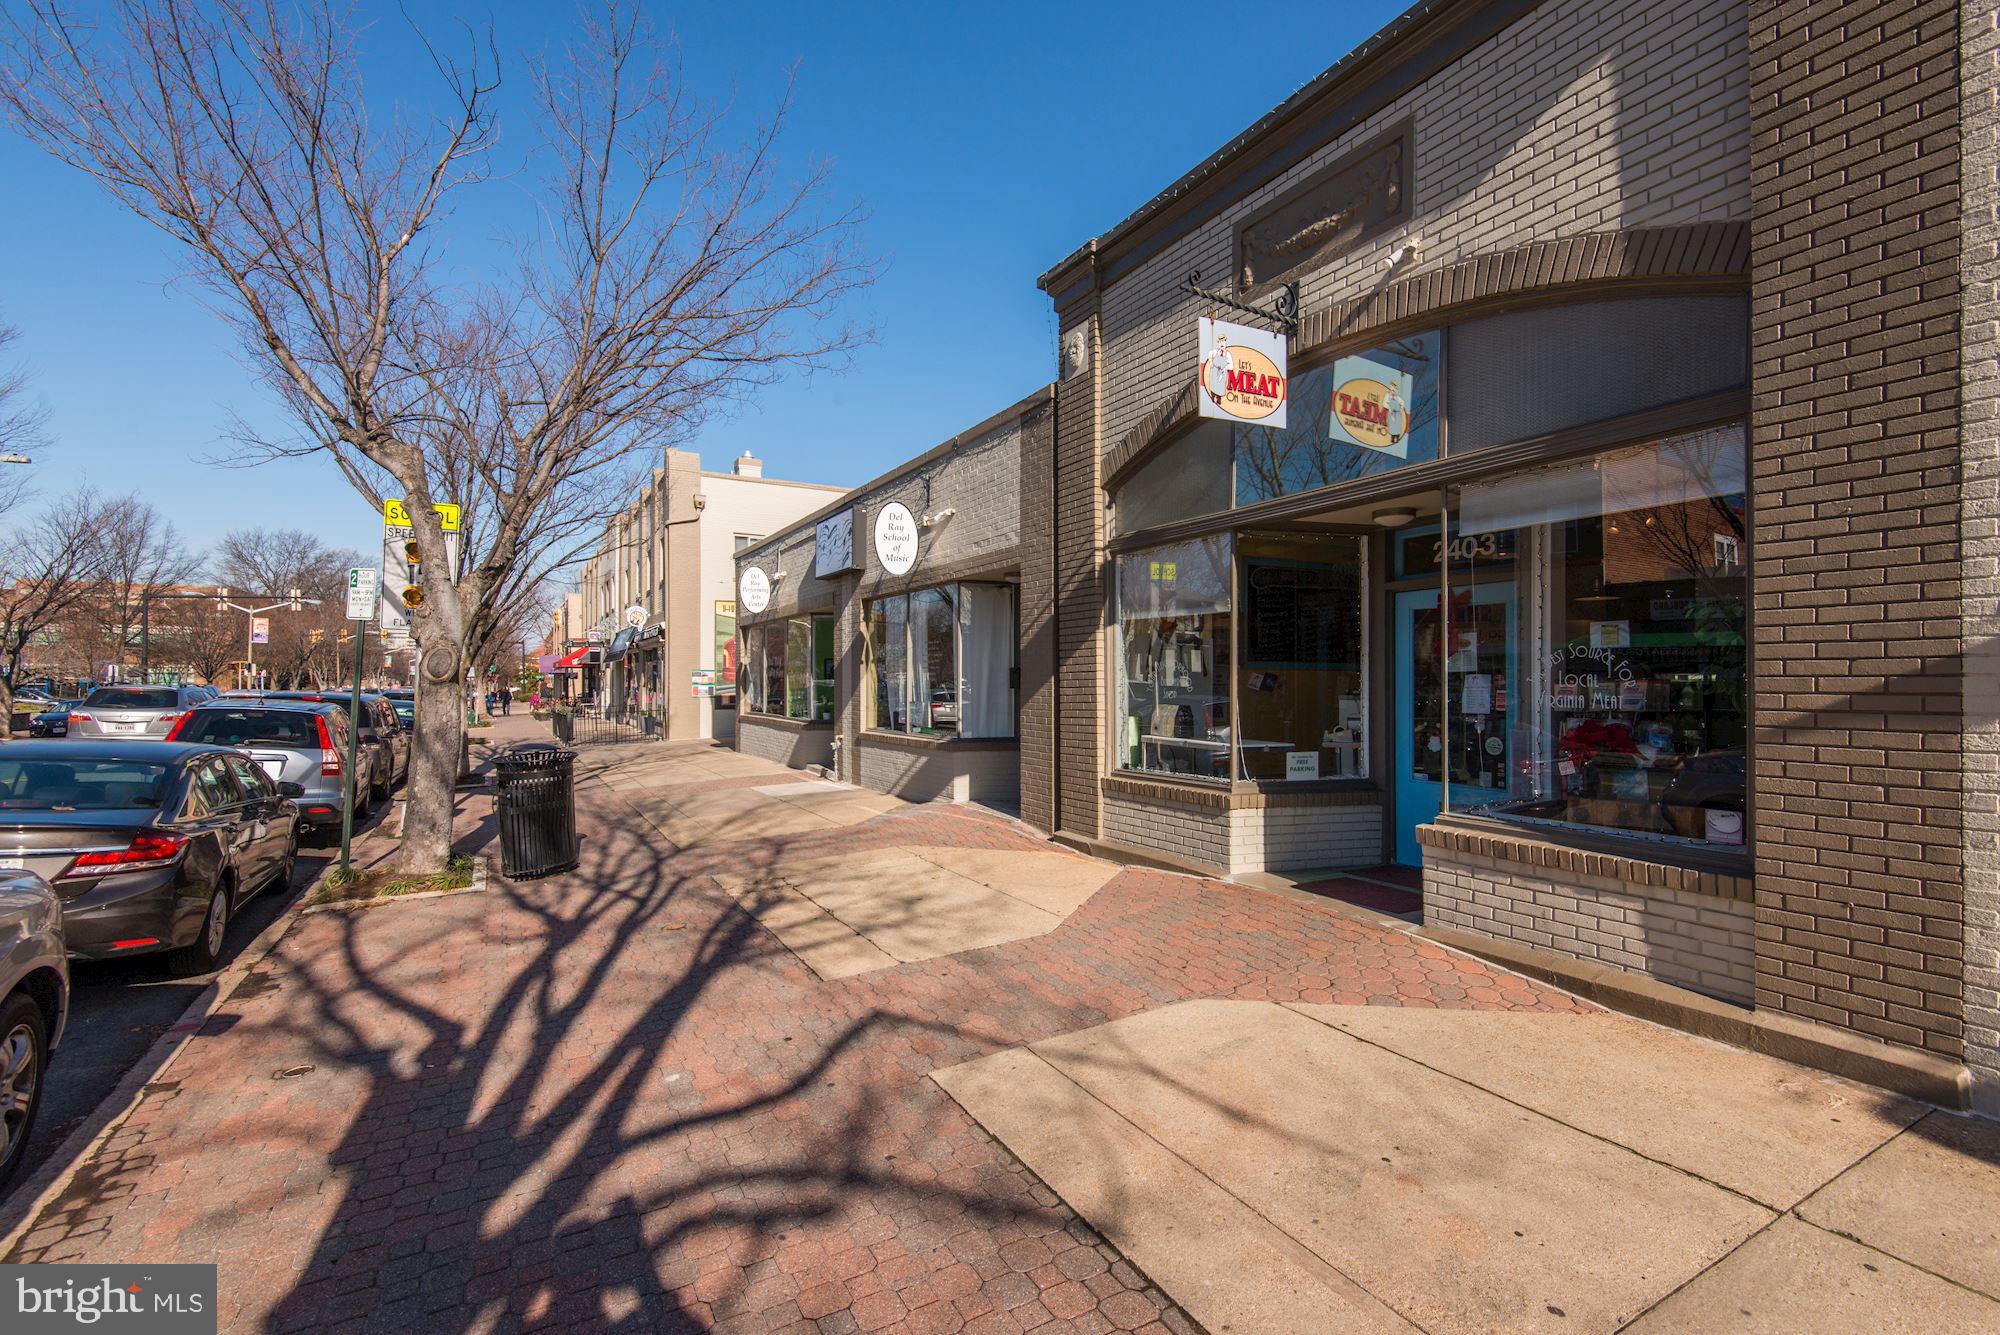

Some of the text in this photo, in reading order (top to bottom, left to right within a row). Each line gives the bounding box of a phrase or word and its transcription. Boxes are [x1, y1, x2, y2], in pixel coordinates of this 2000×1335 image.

[1227, 369, 1280, 399] MEAT
[1226, 391, 1274, 409] ON THE AVENUE
[889, 513, 903, 521] Del
[388, 527, 414, 538] SPEE
[888, 523, 905, 532] Ray
[883, 533, 910, 542] School
[892, 543, 902, 553] of
[1433, 533, 1496, 563] 2403
[885, 553, 910, 562] Music
[351, 572, 358, 586] 2
[1568, 643, 1616, 667] SOURCE
[1614, 660, 1636, 688] FOR
[1558, 670, 1600, 688] LOCAL
[1592, 691, 1623, 709] MEAT
